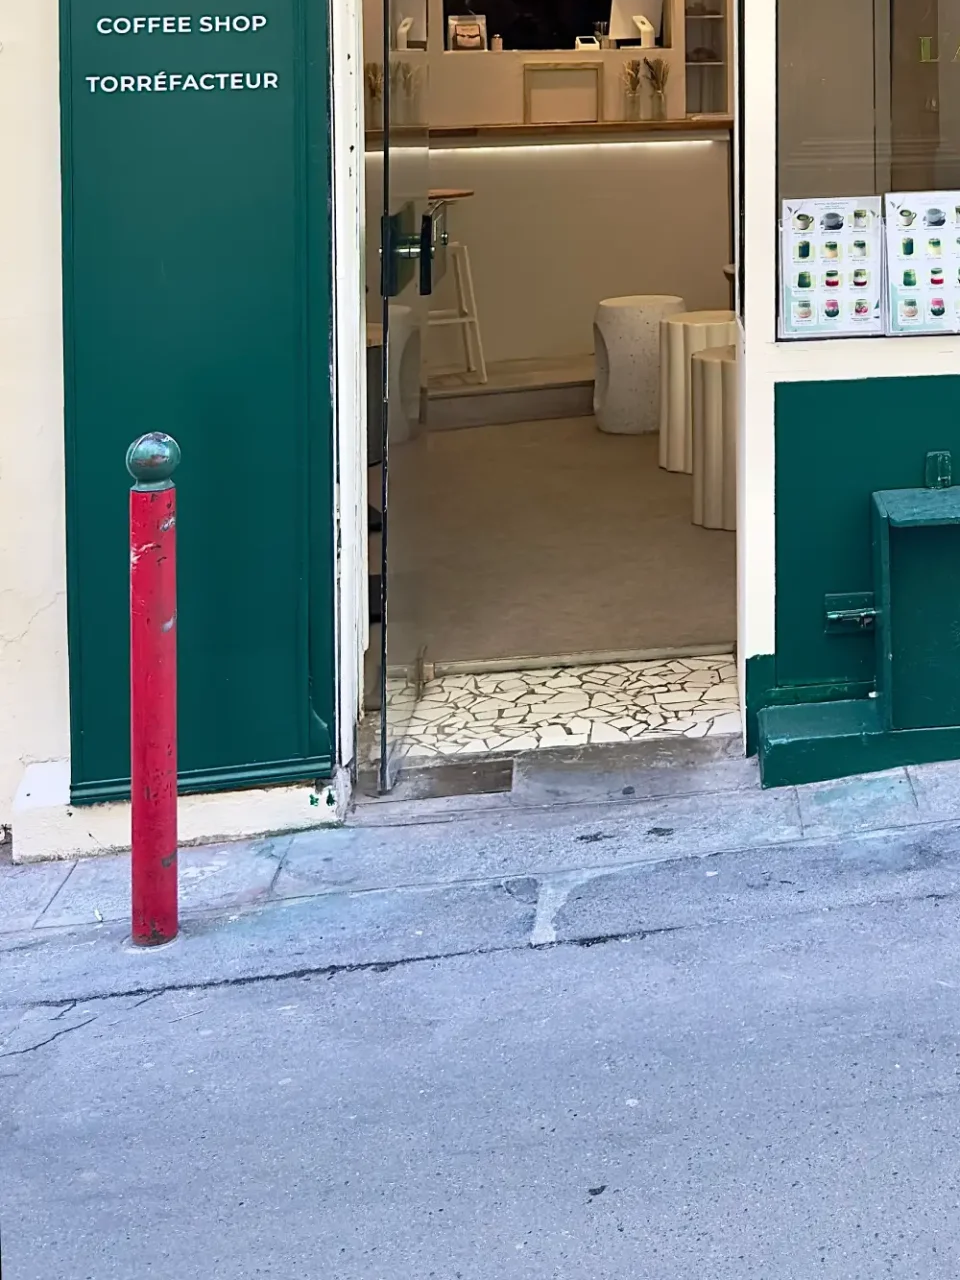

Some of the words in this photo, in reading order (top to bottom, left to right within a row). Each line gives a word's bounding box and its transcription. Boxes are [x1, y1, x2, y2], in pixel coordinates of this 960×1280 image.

[96, 16, 192, 34] COFFEE
[198, 15, 267, 32] SHOP
[85, 71, 279, 94] TORRÉFACTEUR
